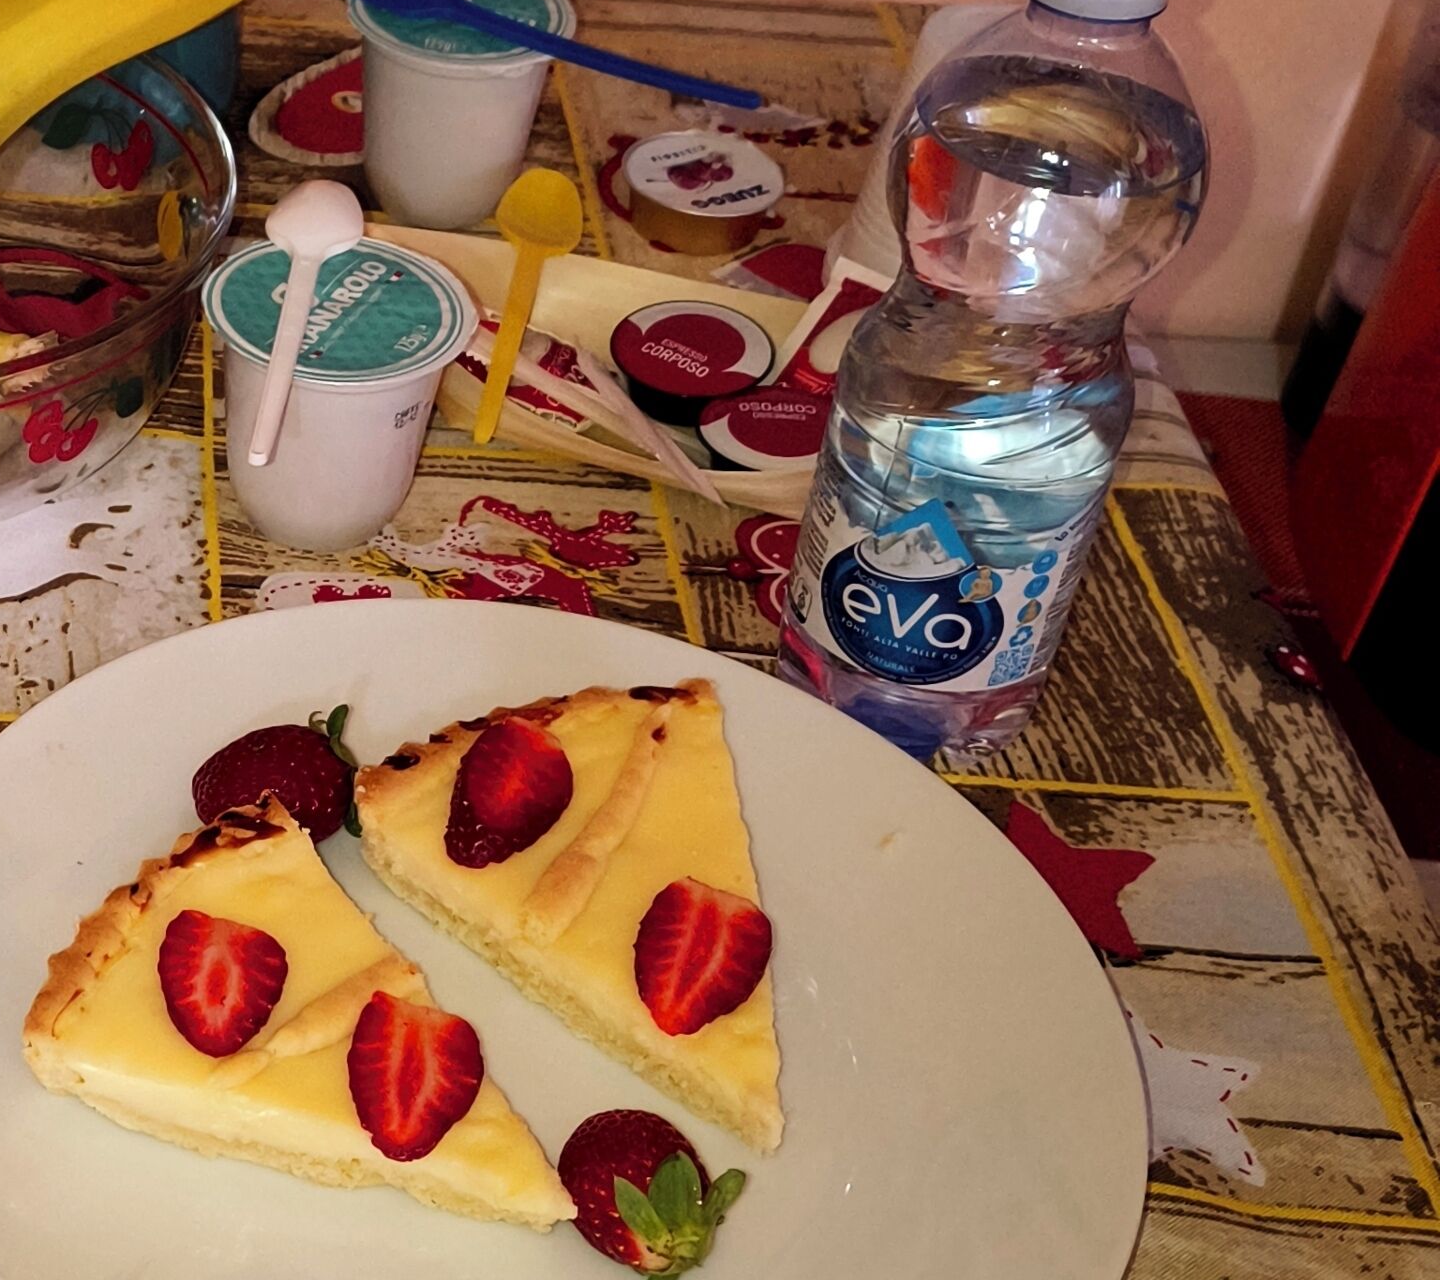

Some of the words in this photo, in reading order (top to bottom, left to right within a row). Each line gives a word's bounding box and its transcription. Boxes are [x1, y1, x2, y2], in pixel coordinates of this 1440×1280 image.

[660, 338, 709, 362] ESPRESSO
[640, 341, 710, 379] CORPOSO
[738, 402, 817, 415] CORPOSO
[874, 634, 900, 649] ALTA
